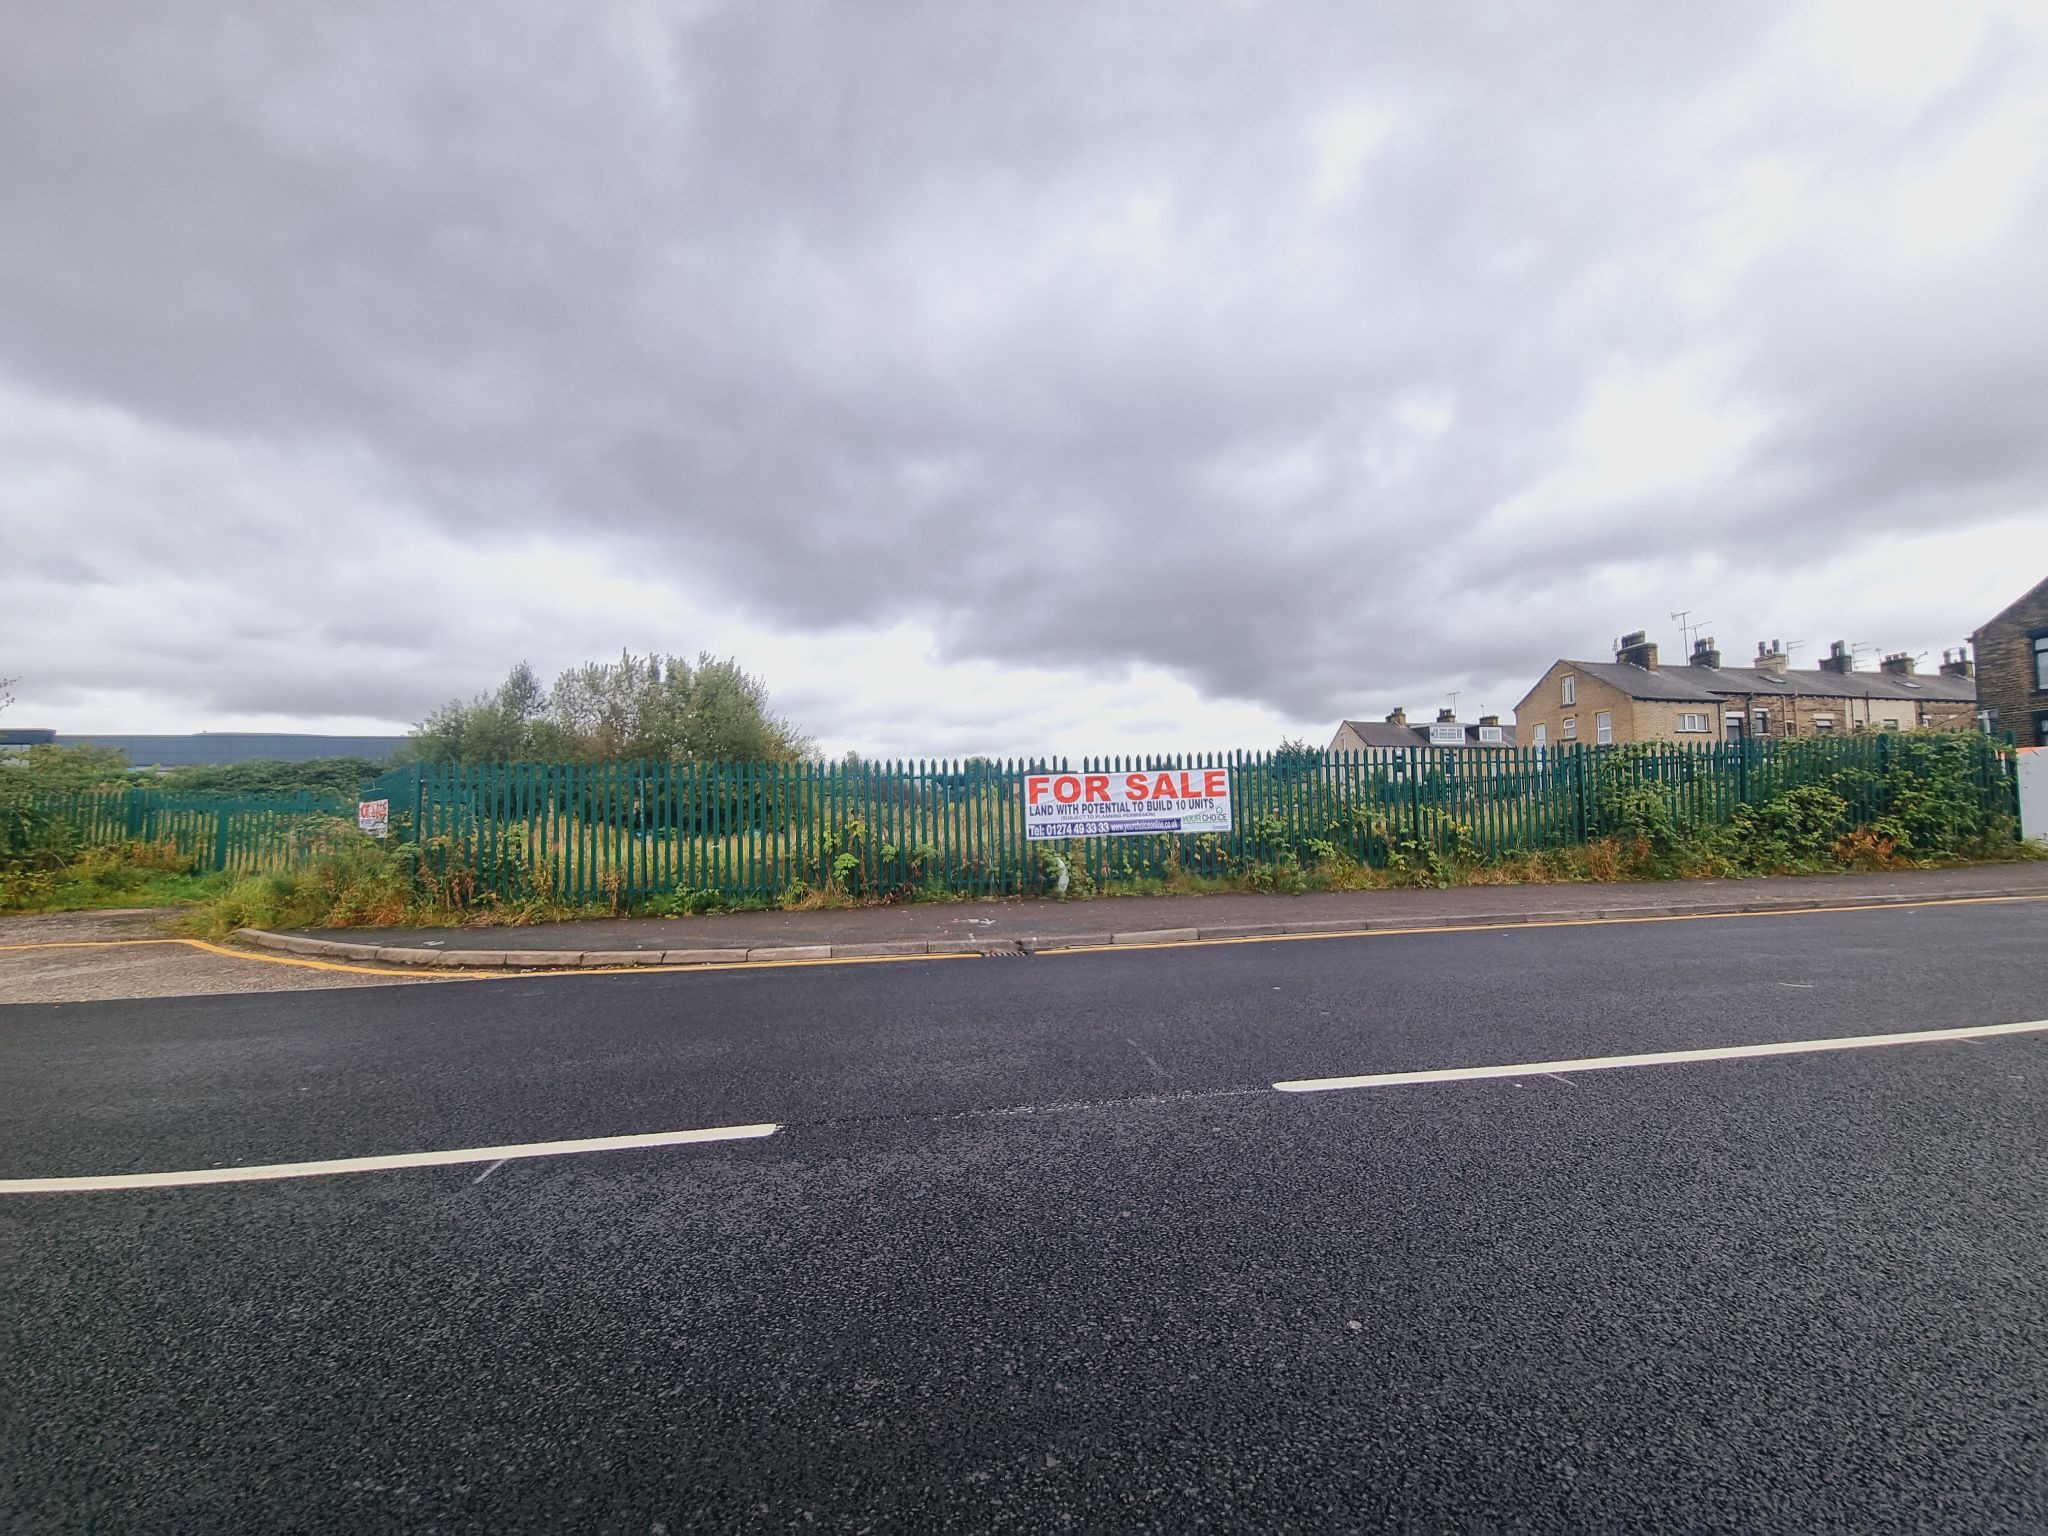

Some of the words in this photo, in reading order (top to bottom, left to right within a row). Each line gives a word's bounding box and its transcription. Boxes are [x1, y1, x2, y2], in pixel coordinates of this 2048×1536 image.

[1029, 776, 1111, 804] FOR
[1125, 771, 1226, 800] SALE
[1030, 804, 1053, 816] LAND
[1056, 804, 1079, 815] WITH
[1082, 802, 1130, 814] POTENTIAL
[1132, 800, 1144, 812] TO
[1147, 800, 1172, 811] BUILD
[1176, 800, 1186, 810] 10
[1189, 798, 1214, 809] UNITS
[1030, 825, 1044, 836] Tel:
[1046, 824, 1071, 835] 01274
[1074, 824, 1084, 834] 49
[1086, 823, 1096, 834] 33
[1099, 823, 1109, 834] 33
